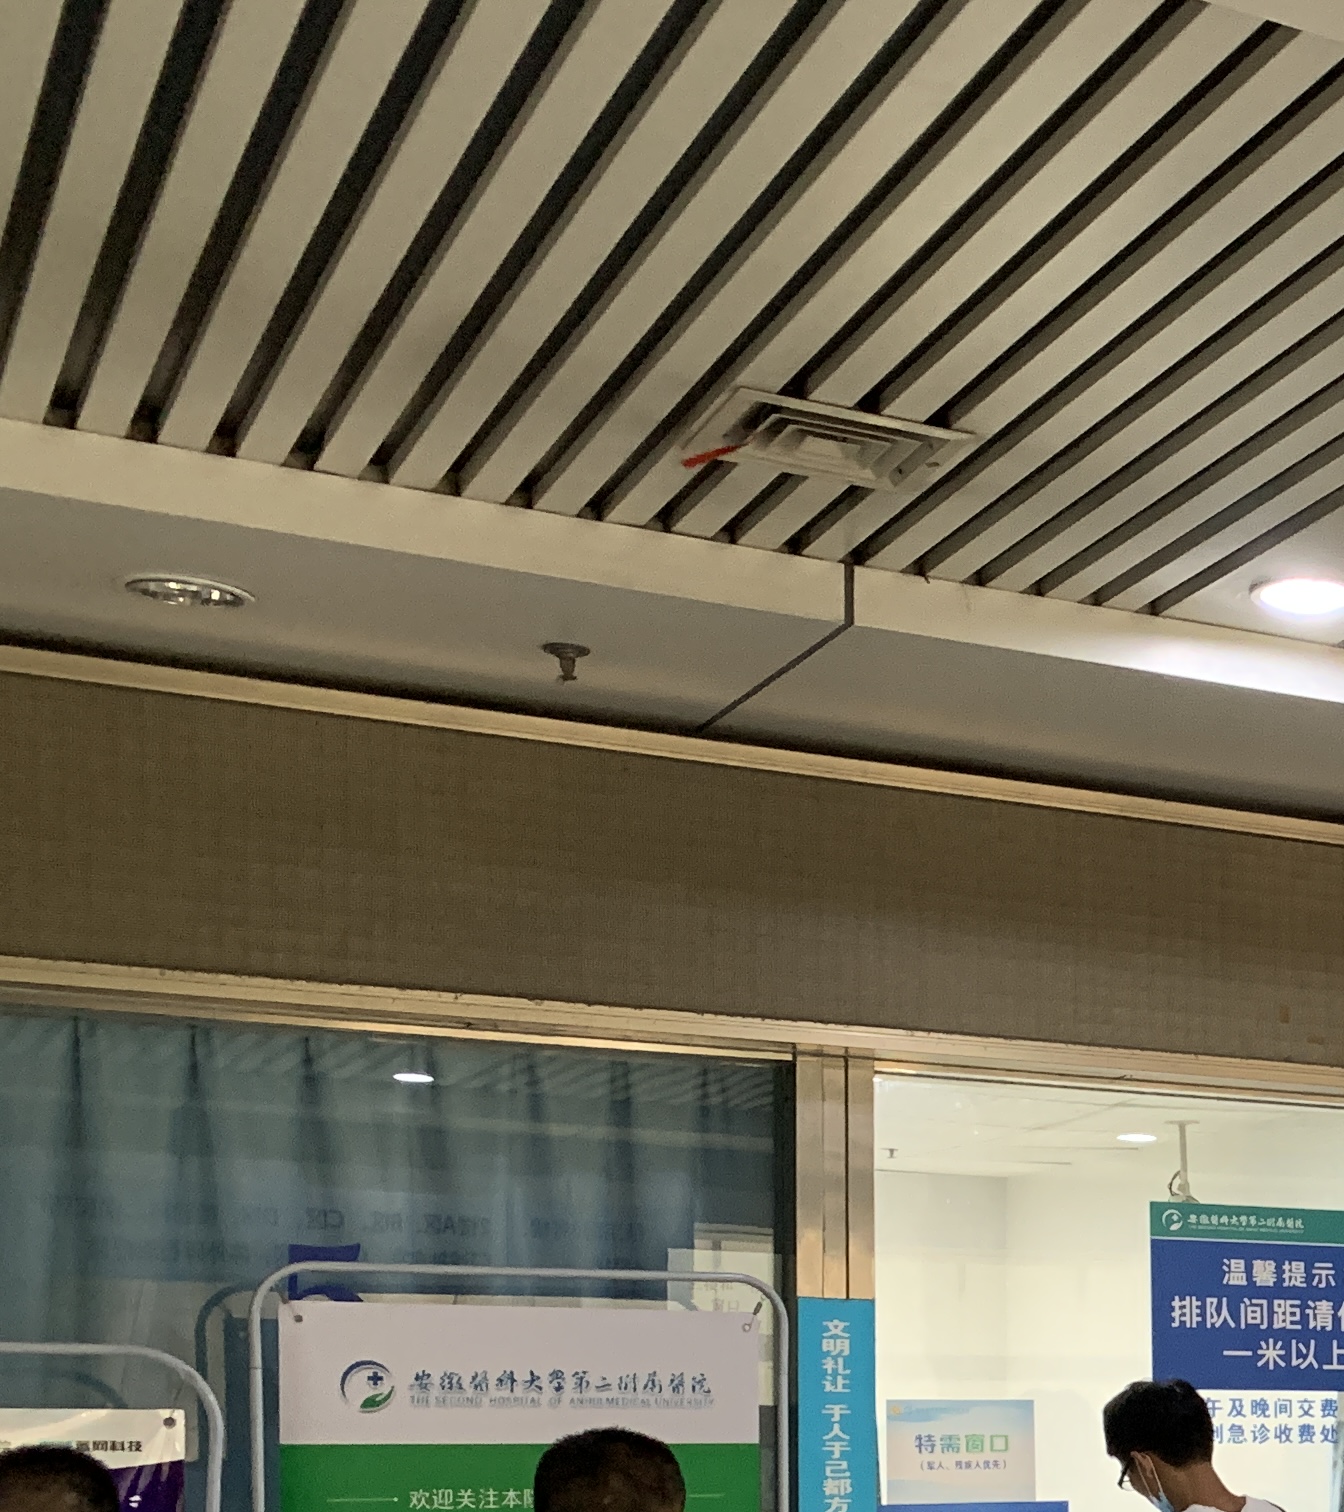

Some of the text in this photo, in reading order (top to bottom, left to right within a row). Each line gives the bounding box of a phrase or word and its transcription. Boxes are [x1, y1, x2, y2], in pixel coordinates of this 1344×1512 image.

[822, 1319, 851, 1393] 文明礼让
[434, 1395, 482, 1408] SECOND
[548, 1395, 562, 1408] OF
[914, 1433, 1009, 1454] 特需窗口
